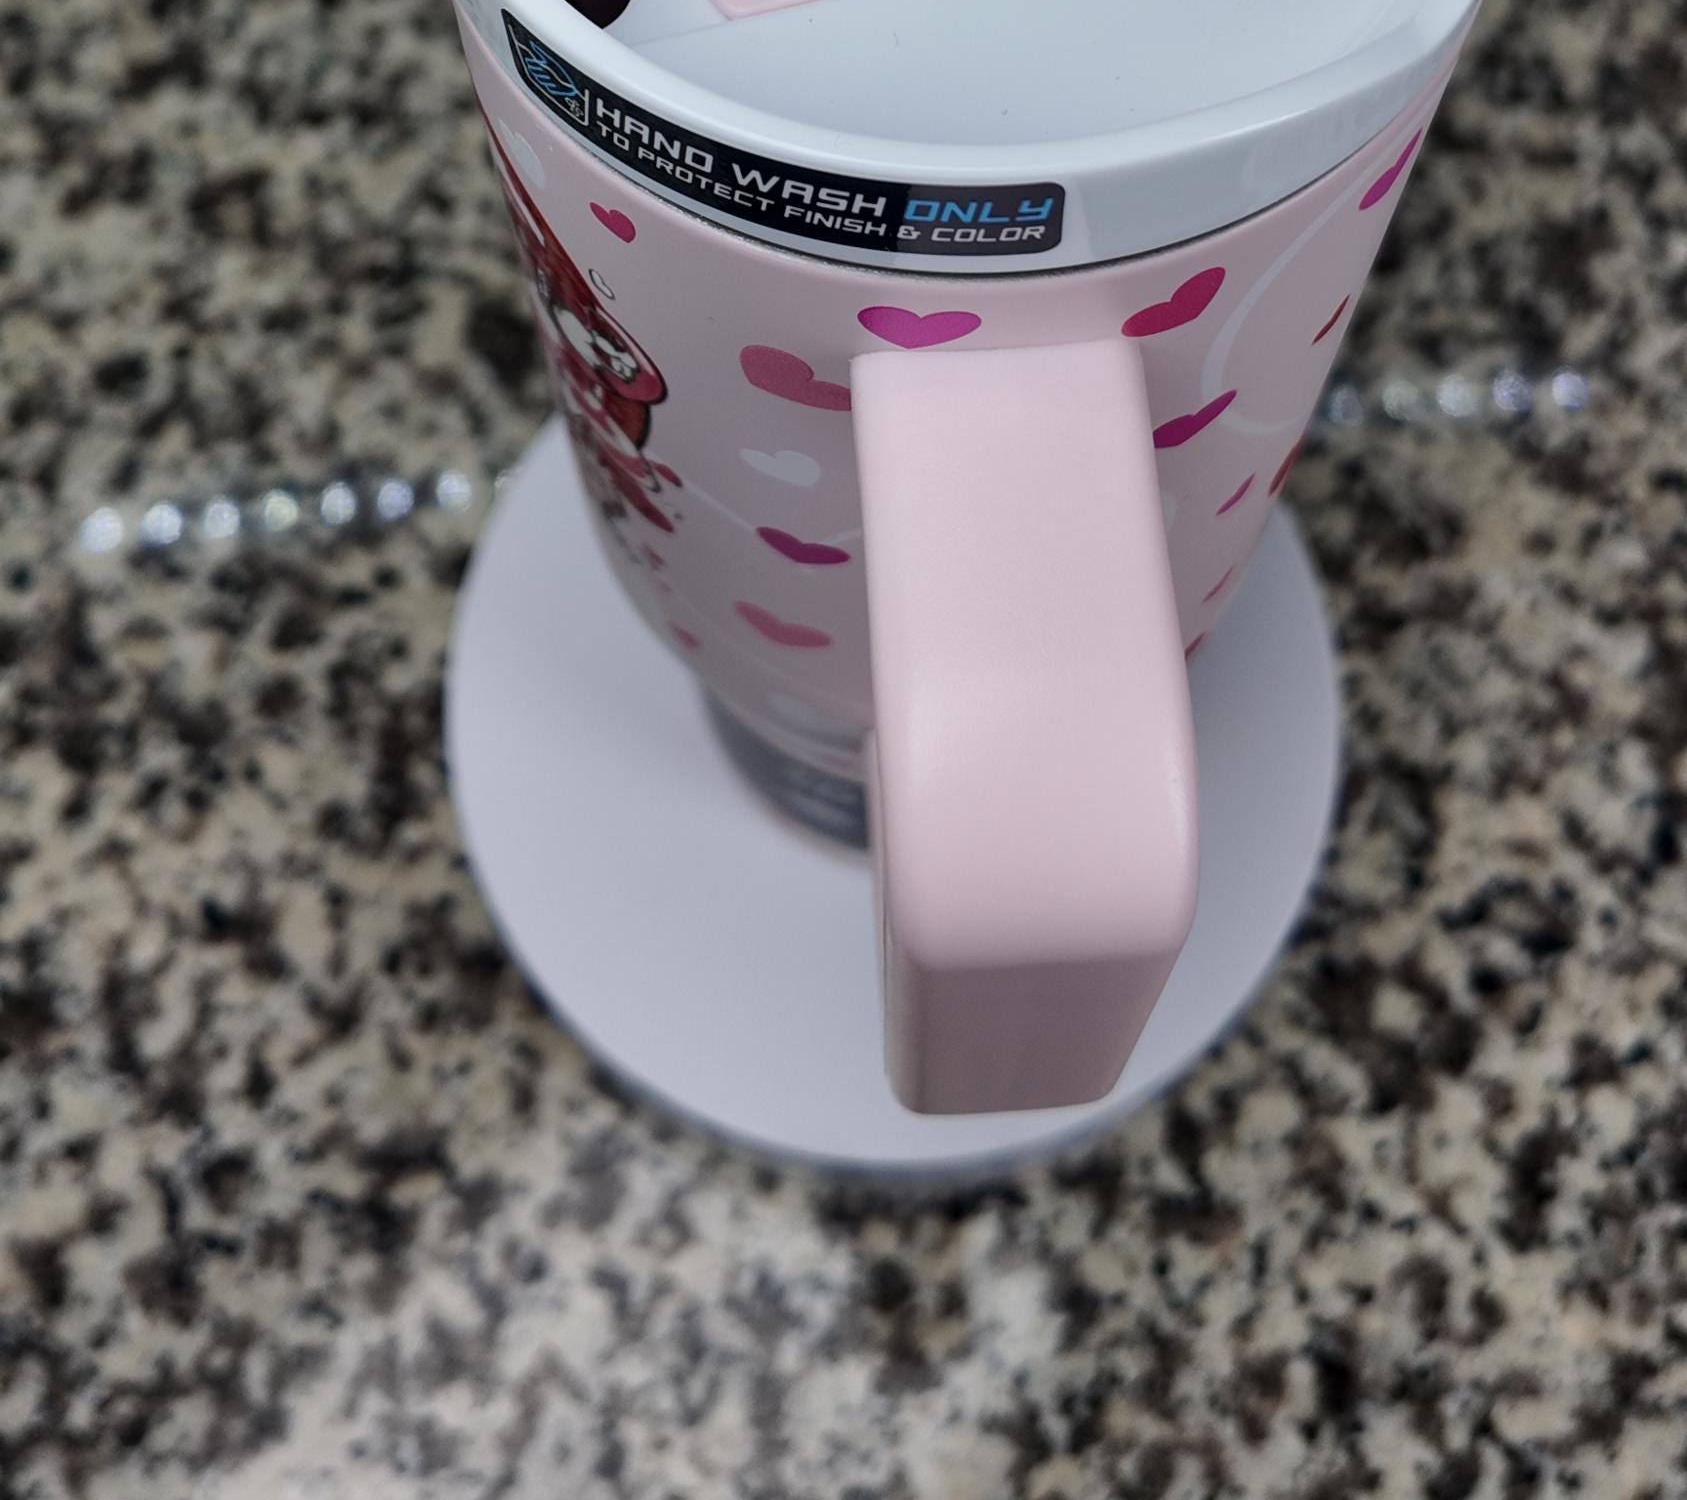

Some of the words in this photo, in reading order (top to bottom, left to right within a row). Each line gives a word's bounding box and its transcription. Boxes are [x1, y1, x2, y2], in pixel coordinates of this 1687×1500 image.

[596, 98, 714, 173] HAND
[732, 163, 887, 218] WASH
[903, 197, 1054, 223] ONLY
[597, 121, 630, 151] TO
[638, 148, 775, 211] PROTECT
[784, 204, 886, 237] FINISH
[897, 225, 921, 239] &
[931, 225, 1046, 242] COLOR
